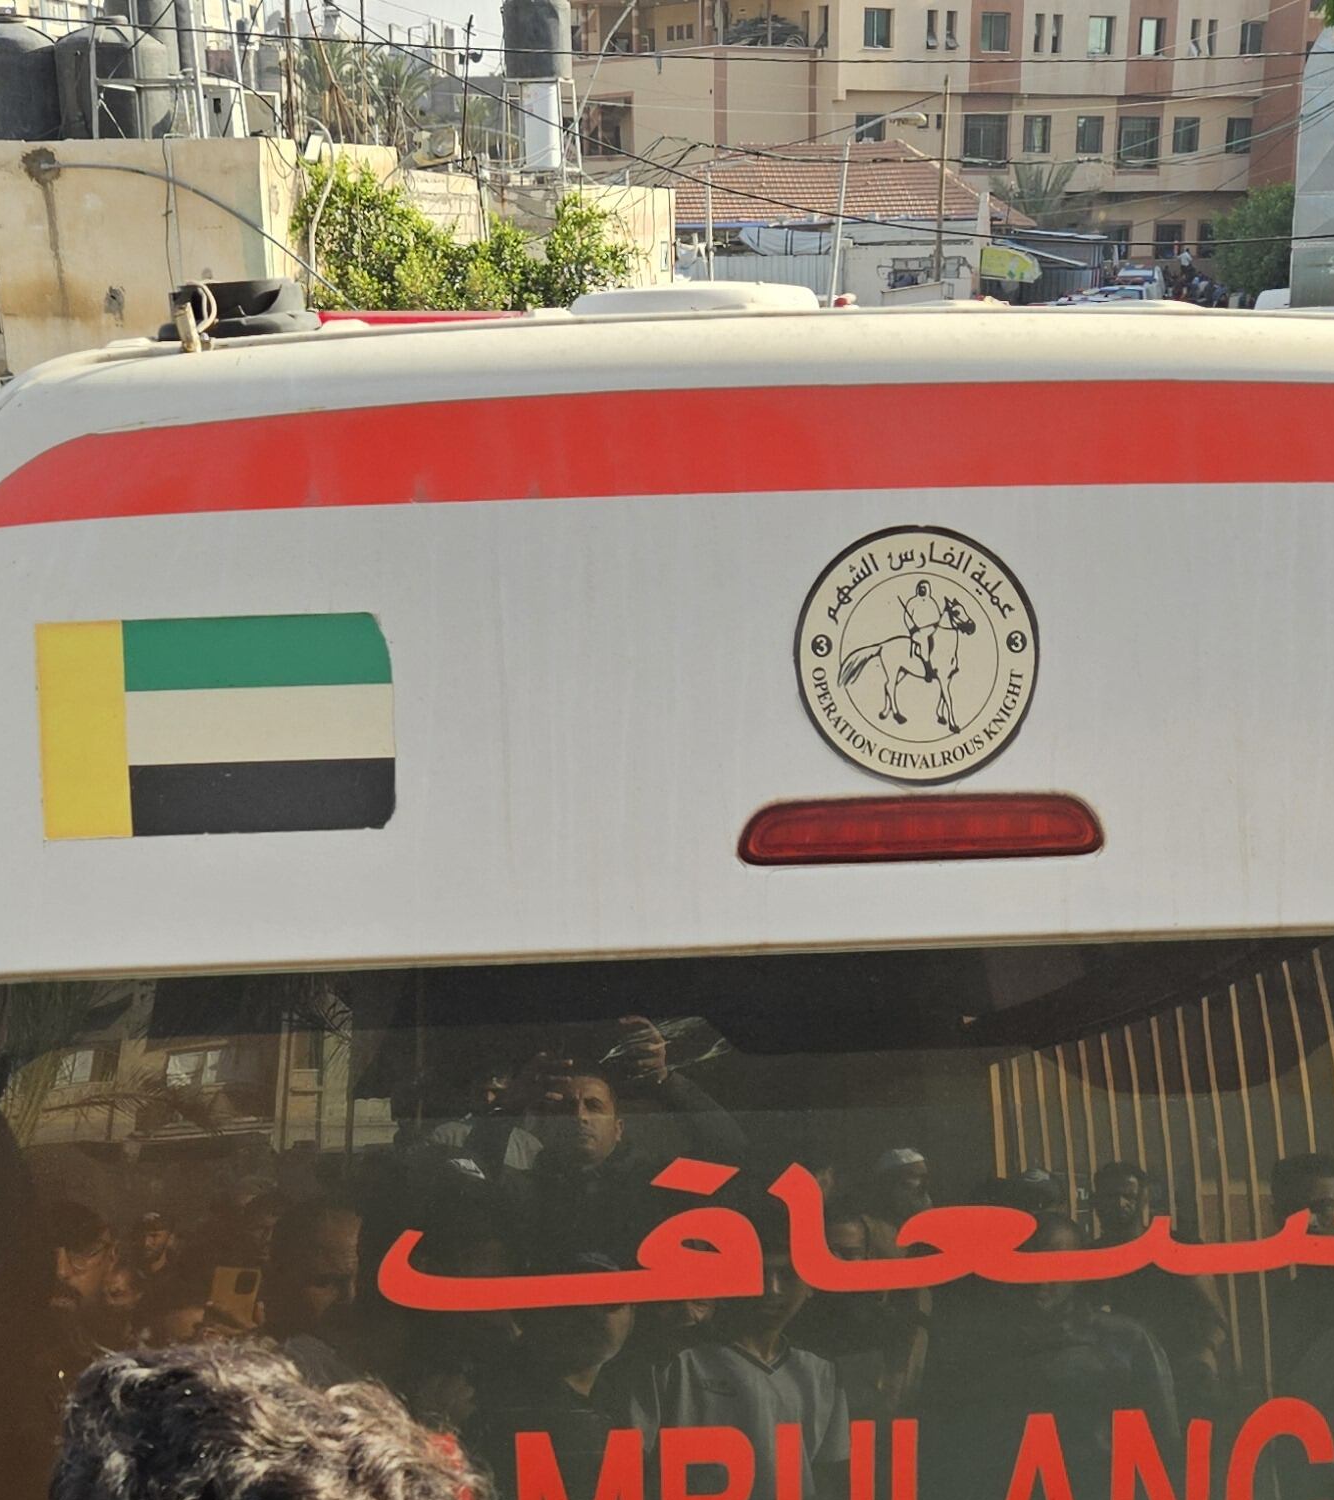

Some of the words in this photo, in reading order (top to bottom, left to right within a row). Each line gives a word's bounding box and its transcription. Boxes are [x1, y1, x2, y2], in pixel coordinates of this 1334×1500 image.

[887, 541, 972, 574] الفارس
[812, 667, 877, 757] OPERATION
[878, 735, 985, 769] CHIVALROUS
[983, 670, 1024, 741] KNIGHT
